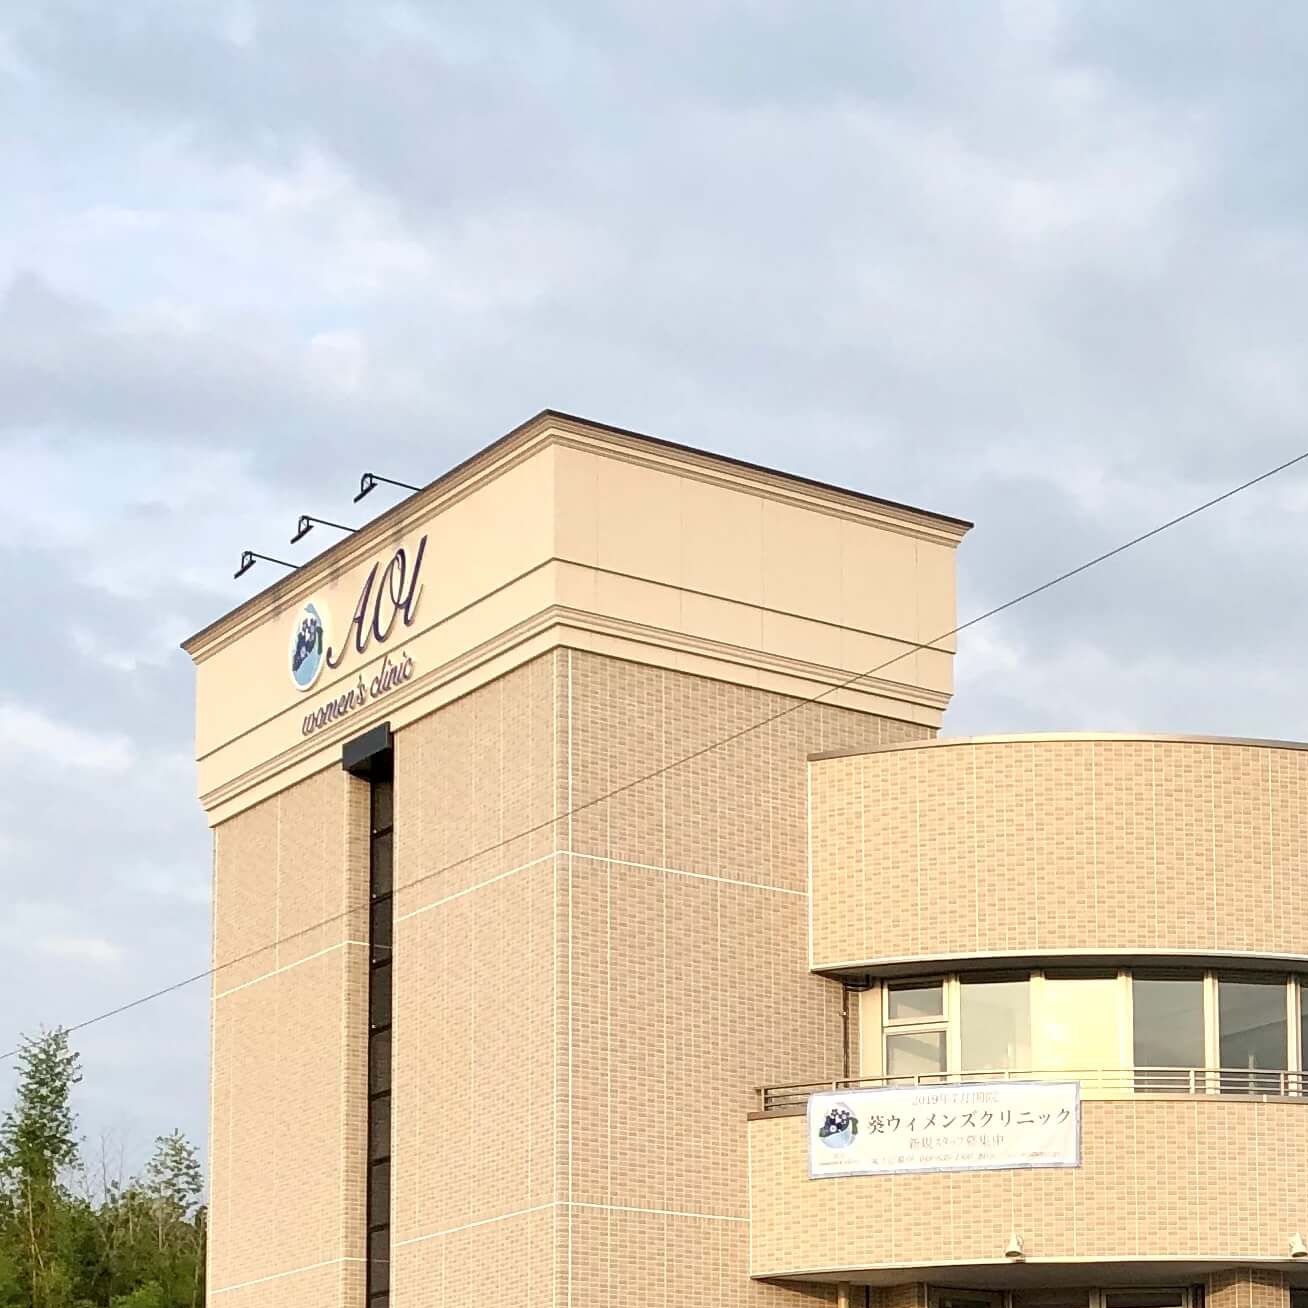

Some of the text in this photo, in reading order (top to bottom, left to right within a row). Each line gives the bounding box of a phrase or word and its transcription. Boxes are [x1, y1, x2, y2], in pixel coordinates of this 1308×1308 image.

[370, 651, 414, 698] clinic
[868, 1108, 1071, 1135] 葵ウィメンズクリニック
